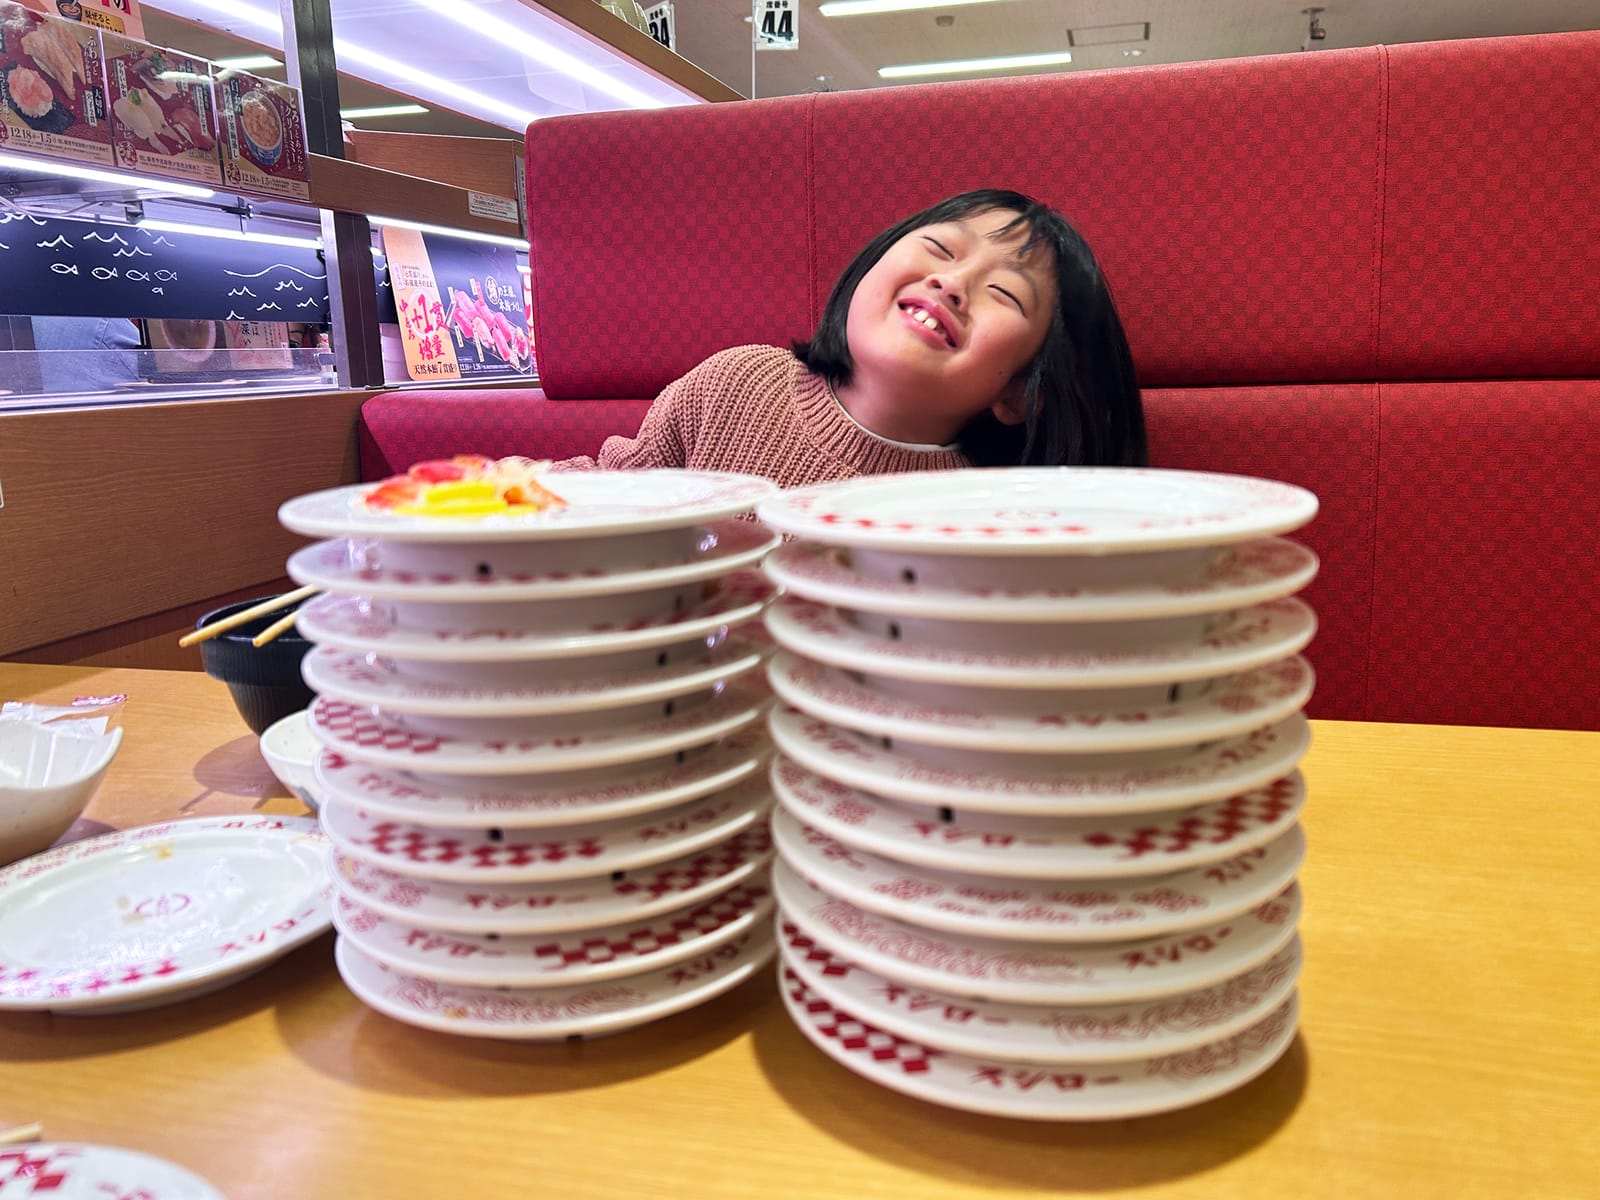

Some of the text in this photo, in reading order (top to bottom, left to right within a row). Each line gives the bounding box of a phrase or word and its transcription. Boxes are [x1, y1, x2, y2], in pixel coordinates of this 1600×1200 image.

[649, 17, 670, 48] 34
[761, 11, 793, 43] 44
[419, 335, 446, 361] 増量
[873, 981, 1012, 1026] スシロー
[970, 1064, 1123, 1091] スシロー
